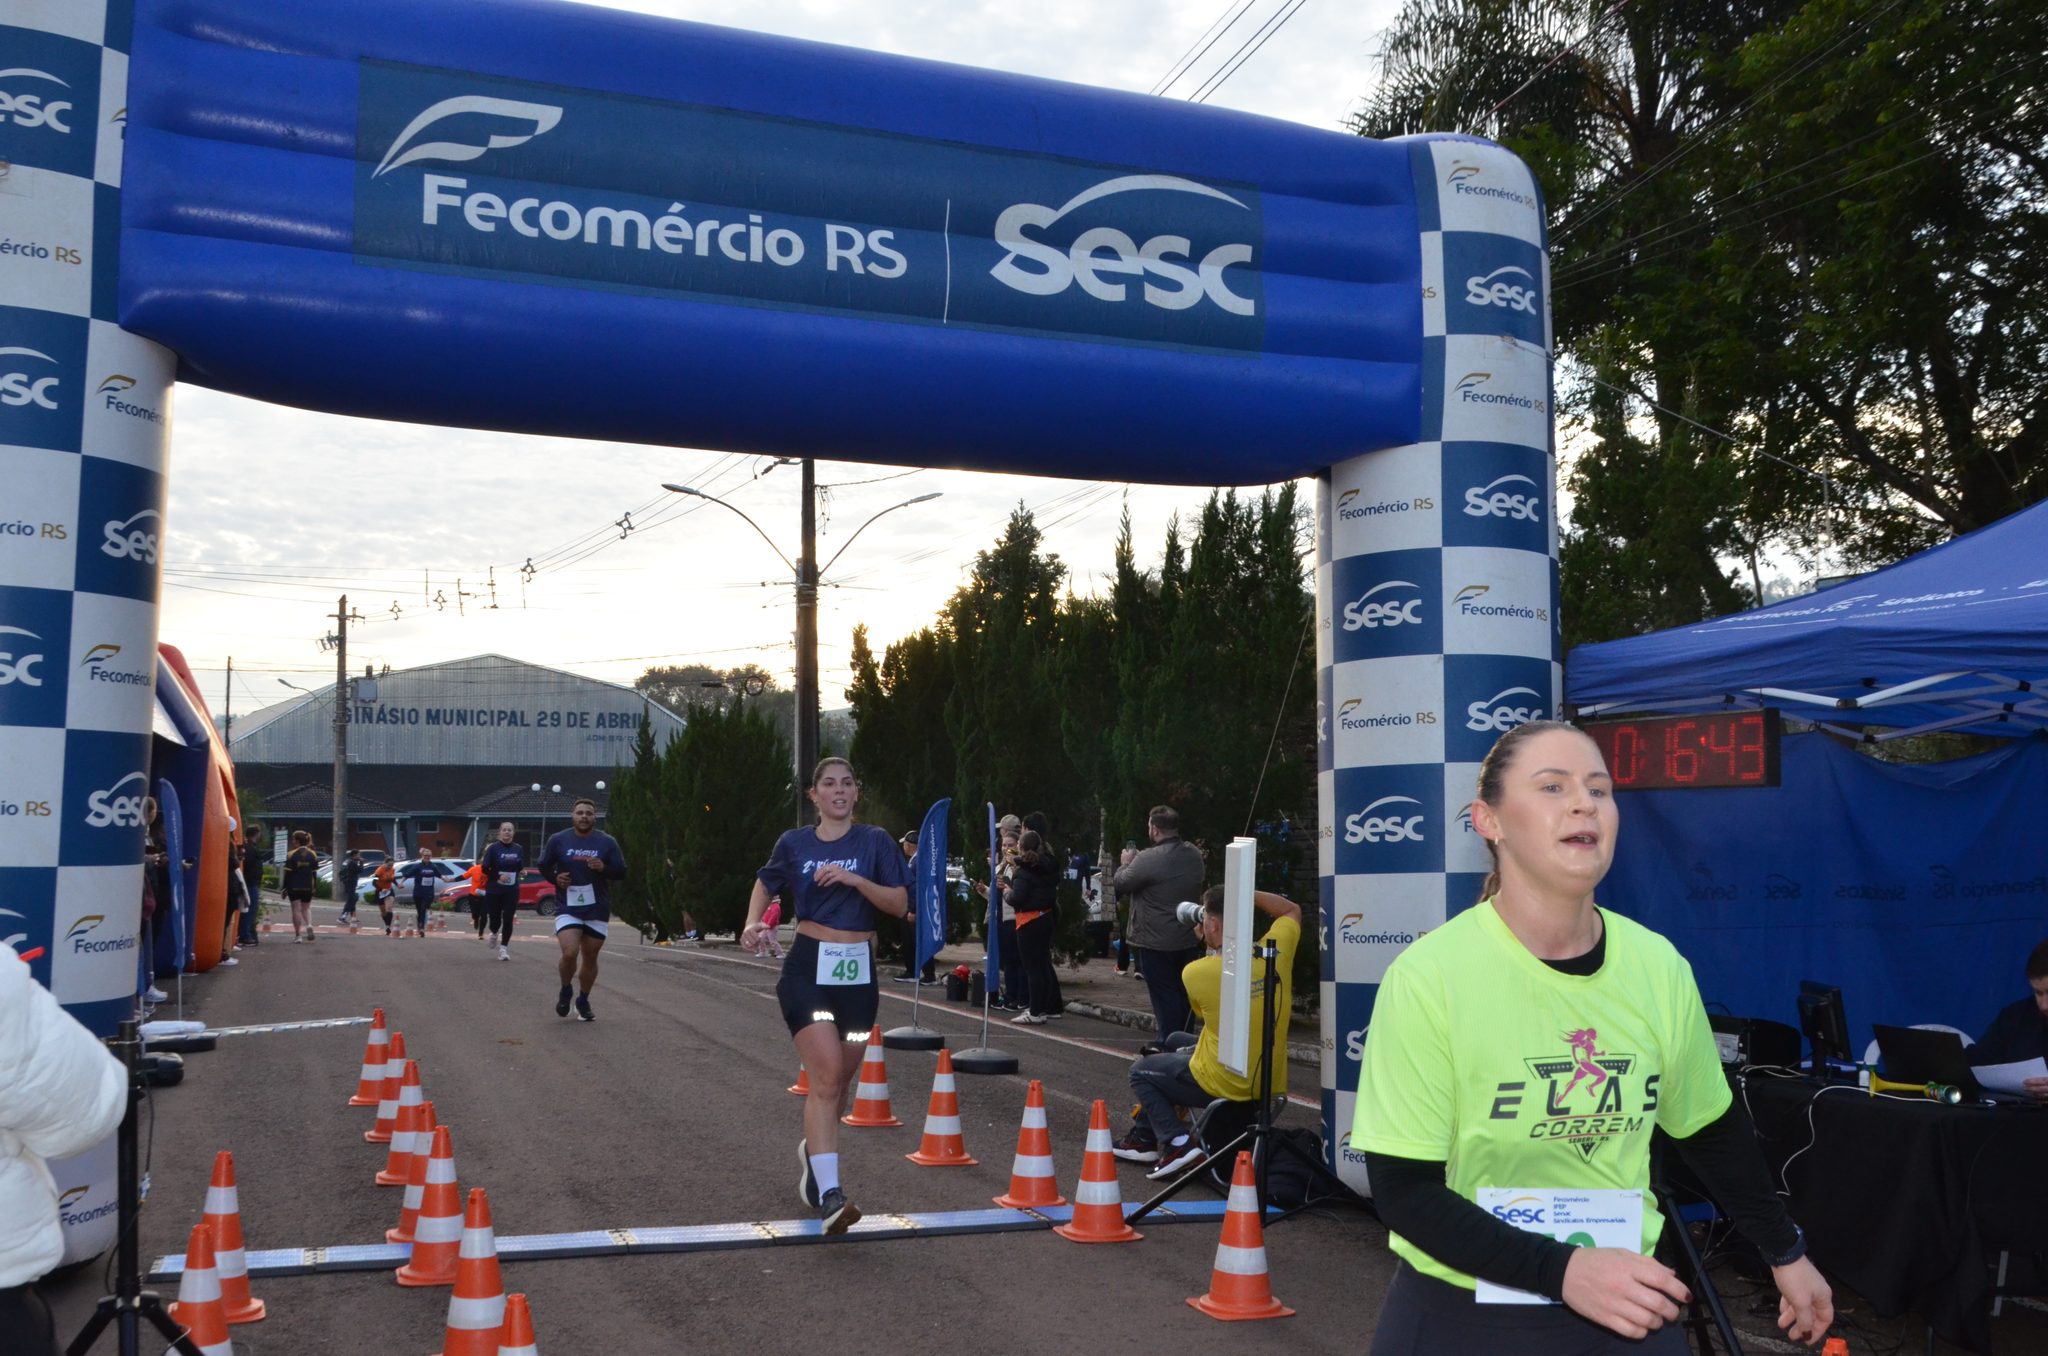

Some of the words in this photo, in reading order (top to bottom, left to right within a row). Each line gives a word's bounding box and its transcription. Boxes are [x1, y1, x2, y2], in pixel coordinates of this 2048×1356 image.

[1456, 183, 1523, 203] Fecomércio
[423, 173, 804, 266] Fecomércio
[826, 223, 907, 278] RS
[56, 247, 82, 265] RS
[990, 203, 1255, 316] Sesc
[1466, 276, 1537, 315] Sesc
[1463, 390, 1532, 408] Fecomércio
[1534, 400, 1545, 413] RS
[1340, 501, 1409, 521] Fecomércio
[1414, 498, 1434, 510] RS
[1463, 487, 1539, 522] Sesc
[41, 523, 67, 539] RS
[1343, 599, 1422, 631] Sesc
[1461, 604, 1534, 619] Fecomércio
[1536, 609, 1548, 621] RS
[426, 708, 530, 727] MUNICIPAL
[537, 710, 561, 728] 29
[567, 711, 590, 729] DE
[1342, 713, 1412, 730] Fecomércio
[1416, 712, 1436, 724] RS
[25, 801, 51, 816] RS
[1344, 814, 1424, 844] Sesc
[1343, 931, 1413, 944] Fecomércio
[832, 959, 859, 981] 49
[1530, 1117, 1643, 1138] CORREM
[1493, 1206, 1545, 1223] Sesc
